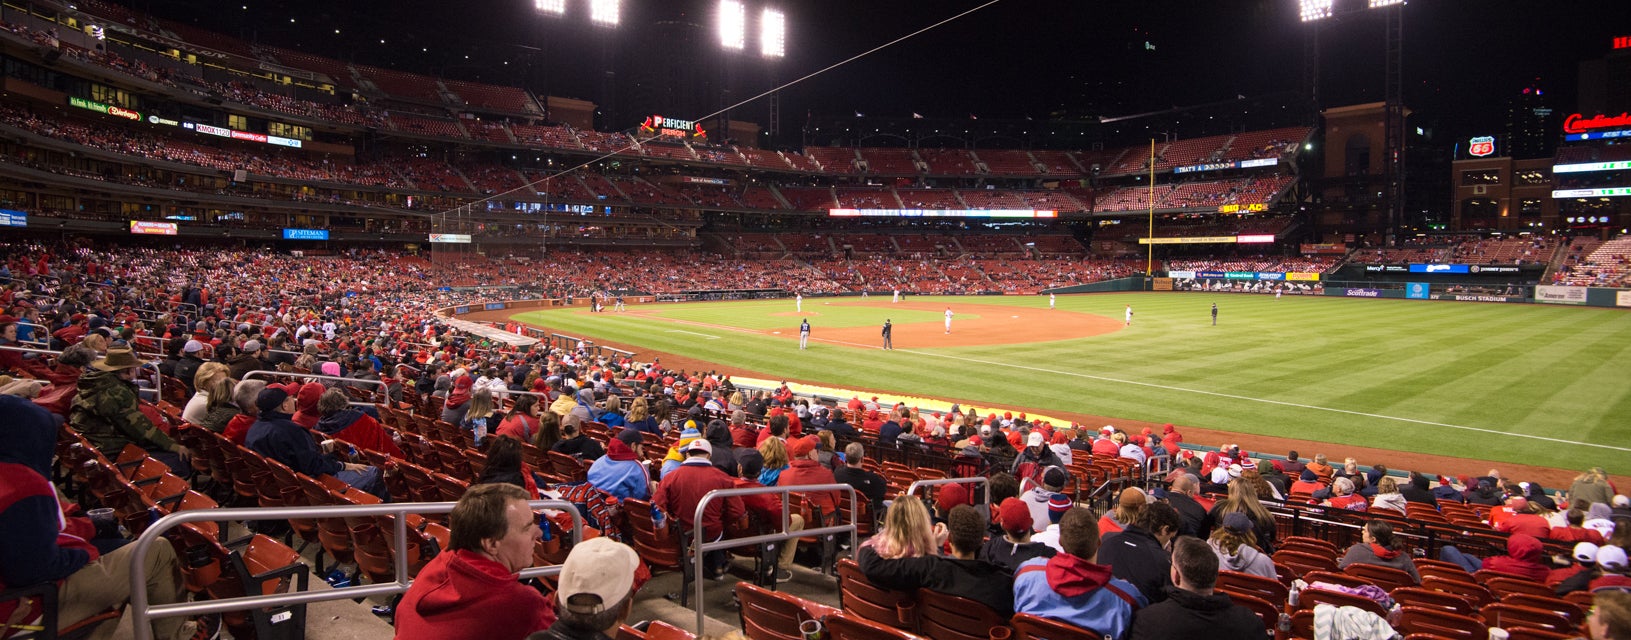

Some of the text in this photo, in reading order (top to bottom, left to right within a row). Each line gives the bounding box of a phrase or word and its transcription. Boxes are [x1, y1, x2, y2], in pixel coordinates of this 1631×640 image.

[653, 115, 694, 130] PERFICIENT
[661, 128, 686, 137] PERCH
[1473, 144, 1490, 153] 66
[1223, 204, 1239, 213] BIG
[1346, 288, 1378, 297] Scottrade
